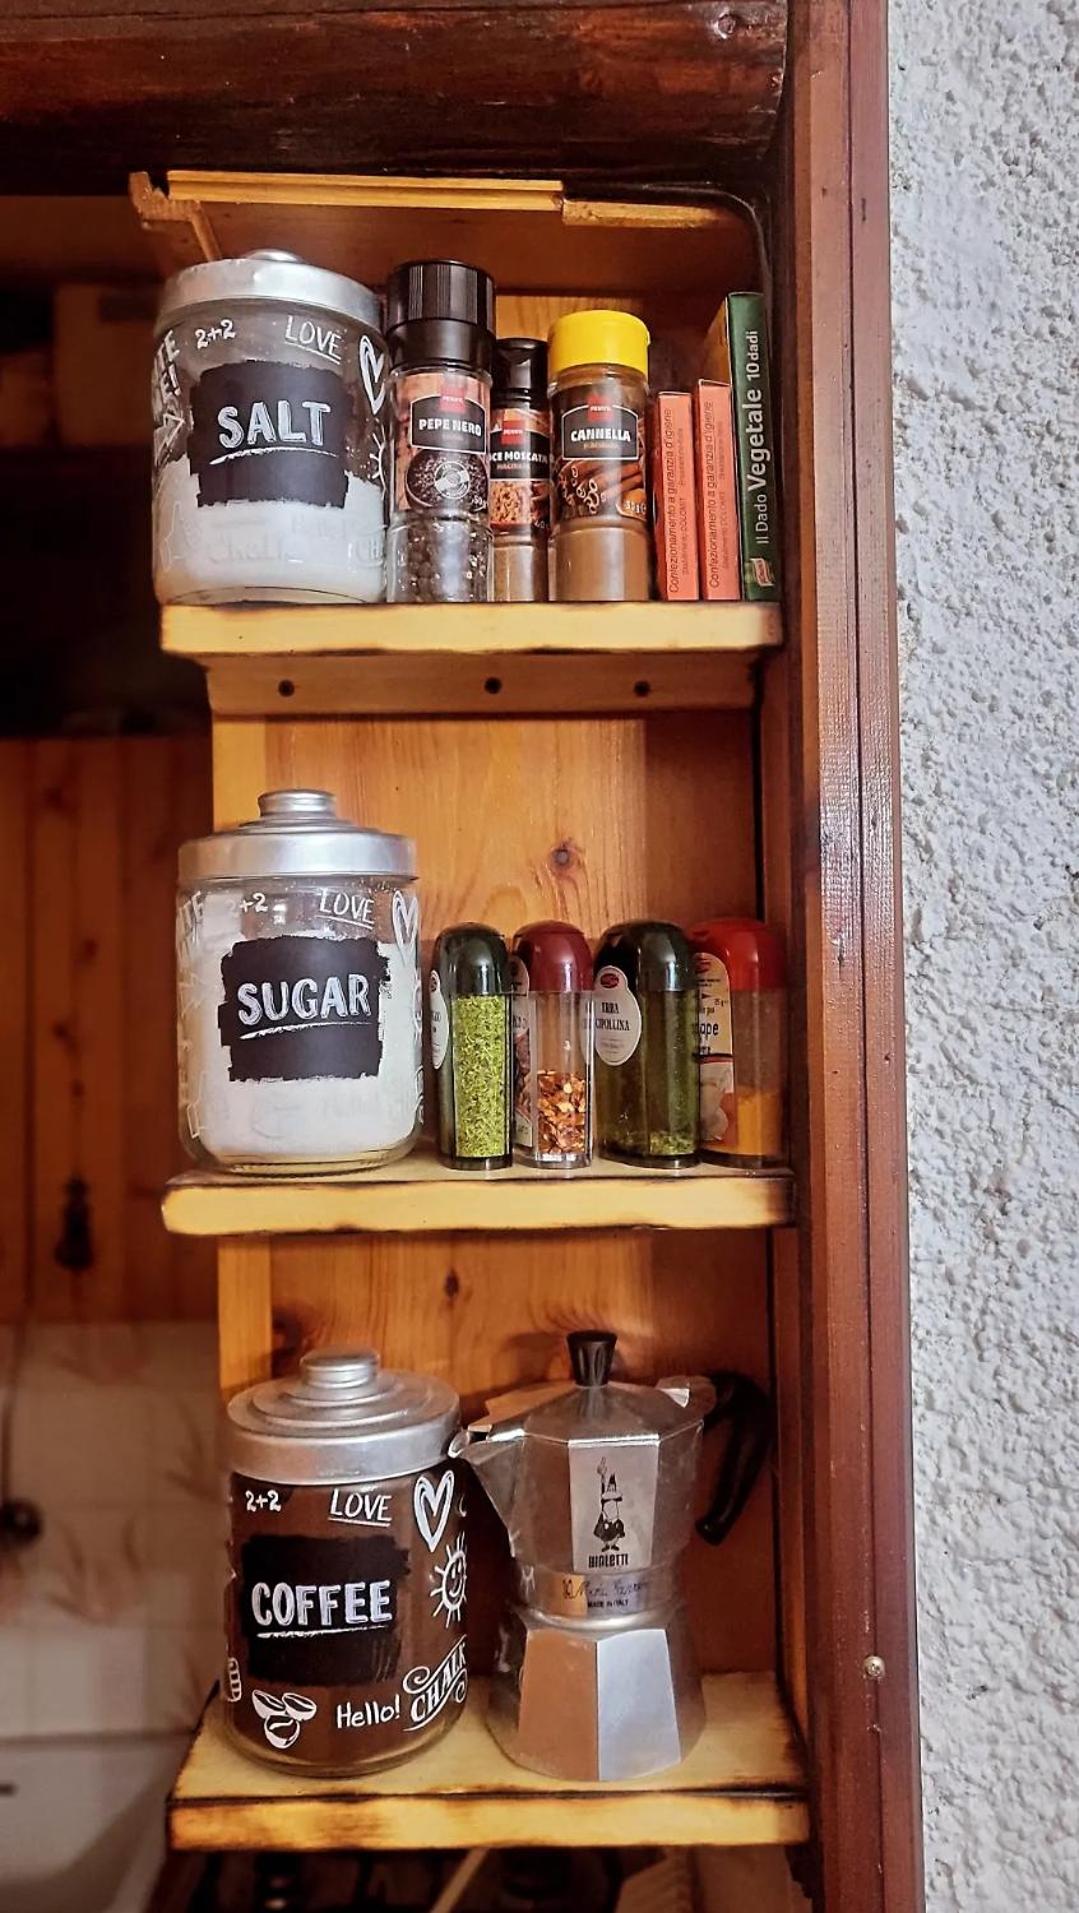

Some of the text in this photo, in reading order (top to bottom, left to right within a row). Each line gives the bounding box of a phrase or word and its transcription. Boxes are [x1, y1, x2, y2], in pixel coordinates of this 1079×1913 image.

[195, 319, 237, 349] 2+2
[285, 315, 344, 352] LOVE
[745, 330, 760, 361] dadi
[746, 362, 760, 381] 10
[217, 401, 331, 450] SALT
[418, 418, 482, 437] PEPE NERO
[570, 428, 631, 442] CANNELLA
[741, 389, 771, 491] Vegetale
[664, 450, 678, 495] garanzia
[703, 444, 717, 489] garanzia
[753, 494, 769, 532] Dado
[666, 504, 680, 593] Confezionamento
[707, 499, 720, 588] Confezionamento
[755, 535, 770, 545] Il
[319, 888, 375, 922] LOVE
[236, 973, 373, 1026] SUGAR
[245, 1488, 392, 1521] 2+2 LOVE
[251, 1579, 393, 1627] COFFEE
[410, 1641, 468, 1722] CHALK
[336, 1694, 400, 1729] Hello!
